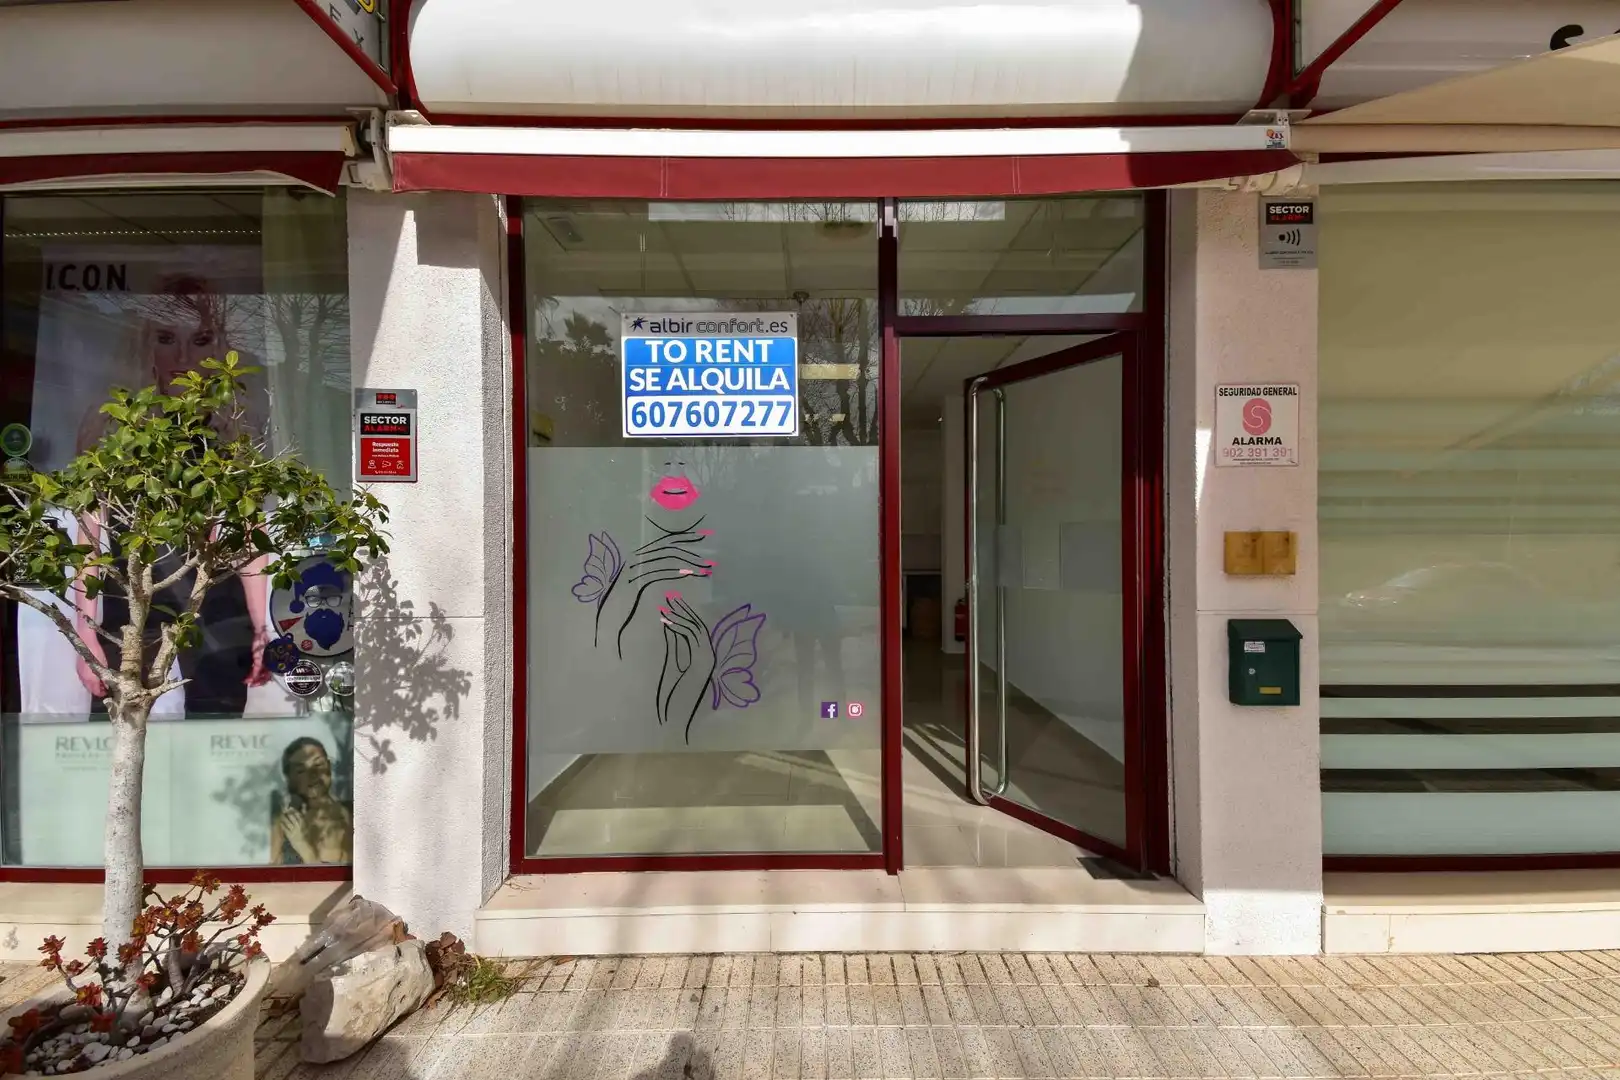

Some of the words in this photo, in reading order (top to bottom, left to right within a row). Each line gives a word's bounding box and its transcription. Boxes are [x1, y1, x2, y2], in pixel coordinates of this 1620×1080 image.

[1269, 205, 1309, 214] SECTOR
[645, 340, 688, 363] TO
[695, 339, 773, 363] RENT
[629, 367, 662, 391] SE
[666, 367, 790, 394] ALQUILA
[1218, 387, 1261, 396] SEGURIDAD
[1262, 387, 1297, 396] GENERAL
[631, 400, 792, 428] 607607277
[364, 415, 407, 425] SECTOR
[1232, 437, 1283, 446] ALARMA
[1222, 447, 1244, 458] 902
[1247, 447, 1268, 458] 391
